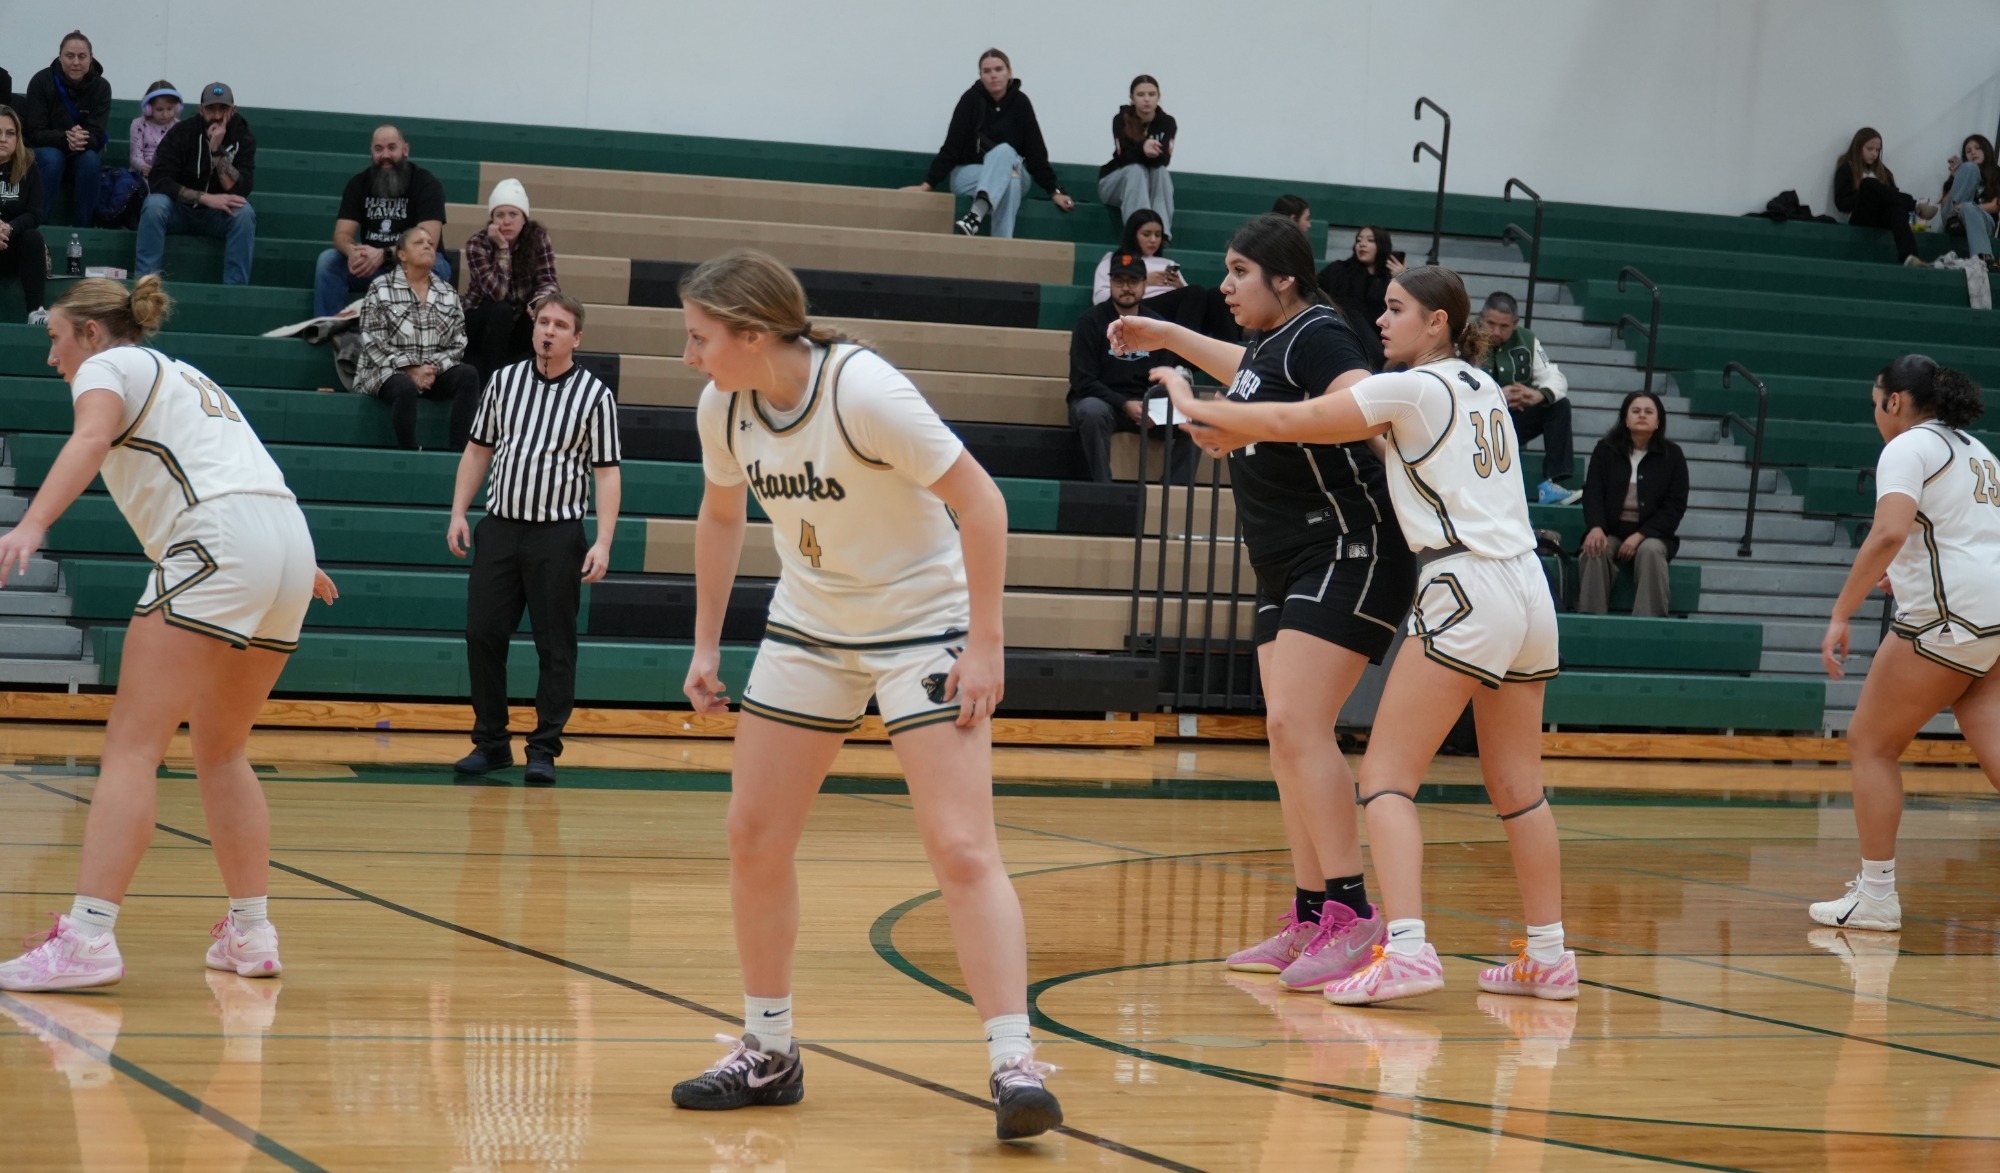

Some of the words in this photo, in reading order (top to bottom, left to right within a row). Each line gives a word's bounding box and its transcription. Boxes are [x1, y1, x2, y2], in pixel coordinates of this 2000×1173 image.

[367, 207, 408, 219] HAWKS
[1509, 345, 1533, 384] B
[180, 371, 242, 422] 22
[1469, 408, 1512, 479] 30
[746, 459, 846, 502] Hawks
[1969, 457, 2000, 508] 23
[799, 518, 823, 569] 4
